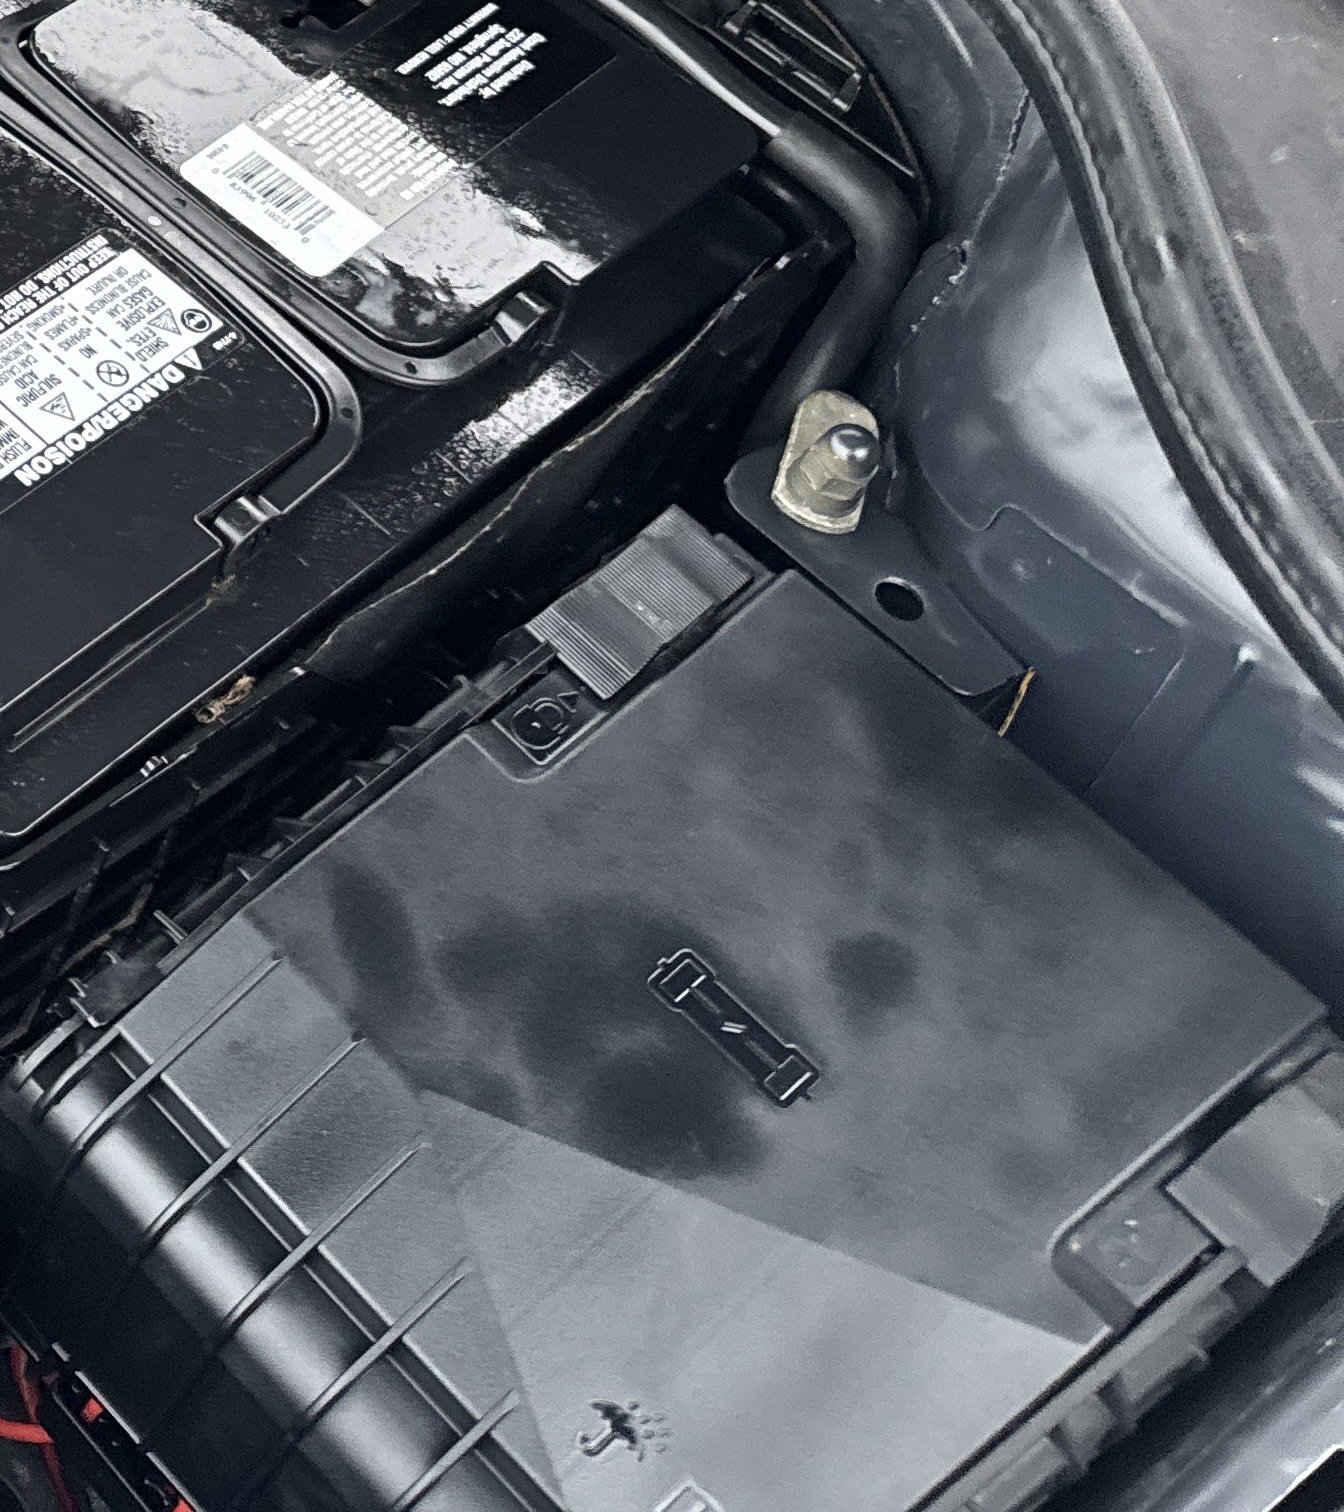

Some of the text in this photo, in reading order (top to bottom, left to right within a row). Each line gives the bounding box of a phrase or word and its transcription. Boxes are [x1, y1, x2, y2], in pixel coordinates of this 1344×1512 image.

[488, 58, 535, 93] Distributed
[32, 233, 109, 284] INSTRUCTIONS.
[86, 246, 118, 269] KEEP
[52, 275, 70, 292] OF
[65, 262, 90, 283] OUT
[85, 265, 129, 296] OR INJURY.
[18, 278, 40, 296] DO
[31, 285, 57, 304] THE
[84, 268, 152, 316] CAUSE BLINDNESS
[0, 297, 38, 326] REACH
[105, 285, 154, 320] GASES CAN
[115, 295, 167, 332] EXPLOSIVE
[125, 325, 157, 347] EYES.
[134, 336, 169, 363] SHIELD
[17, 353, 39, 370] CAN
[78, 343, 98, 359] NO
[13, 368, 40, 390] ACID
[15, 373, 63, 408] SULFURIC
[13, 363, 186, 487] DANGER/POISON
[0, 437, 33, 464] FLUSH
